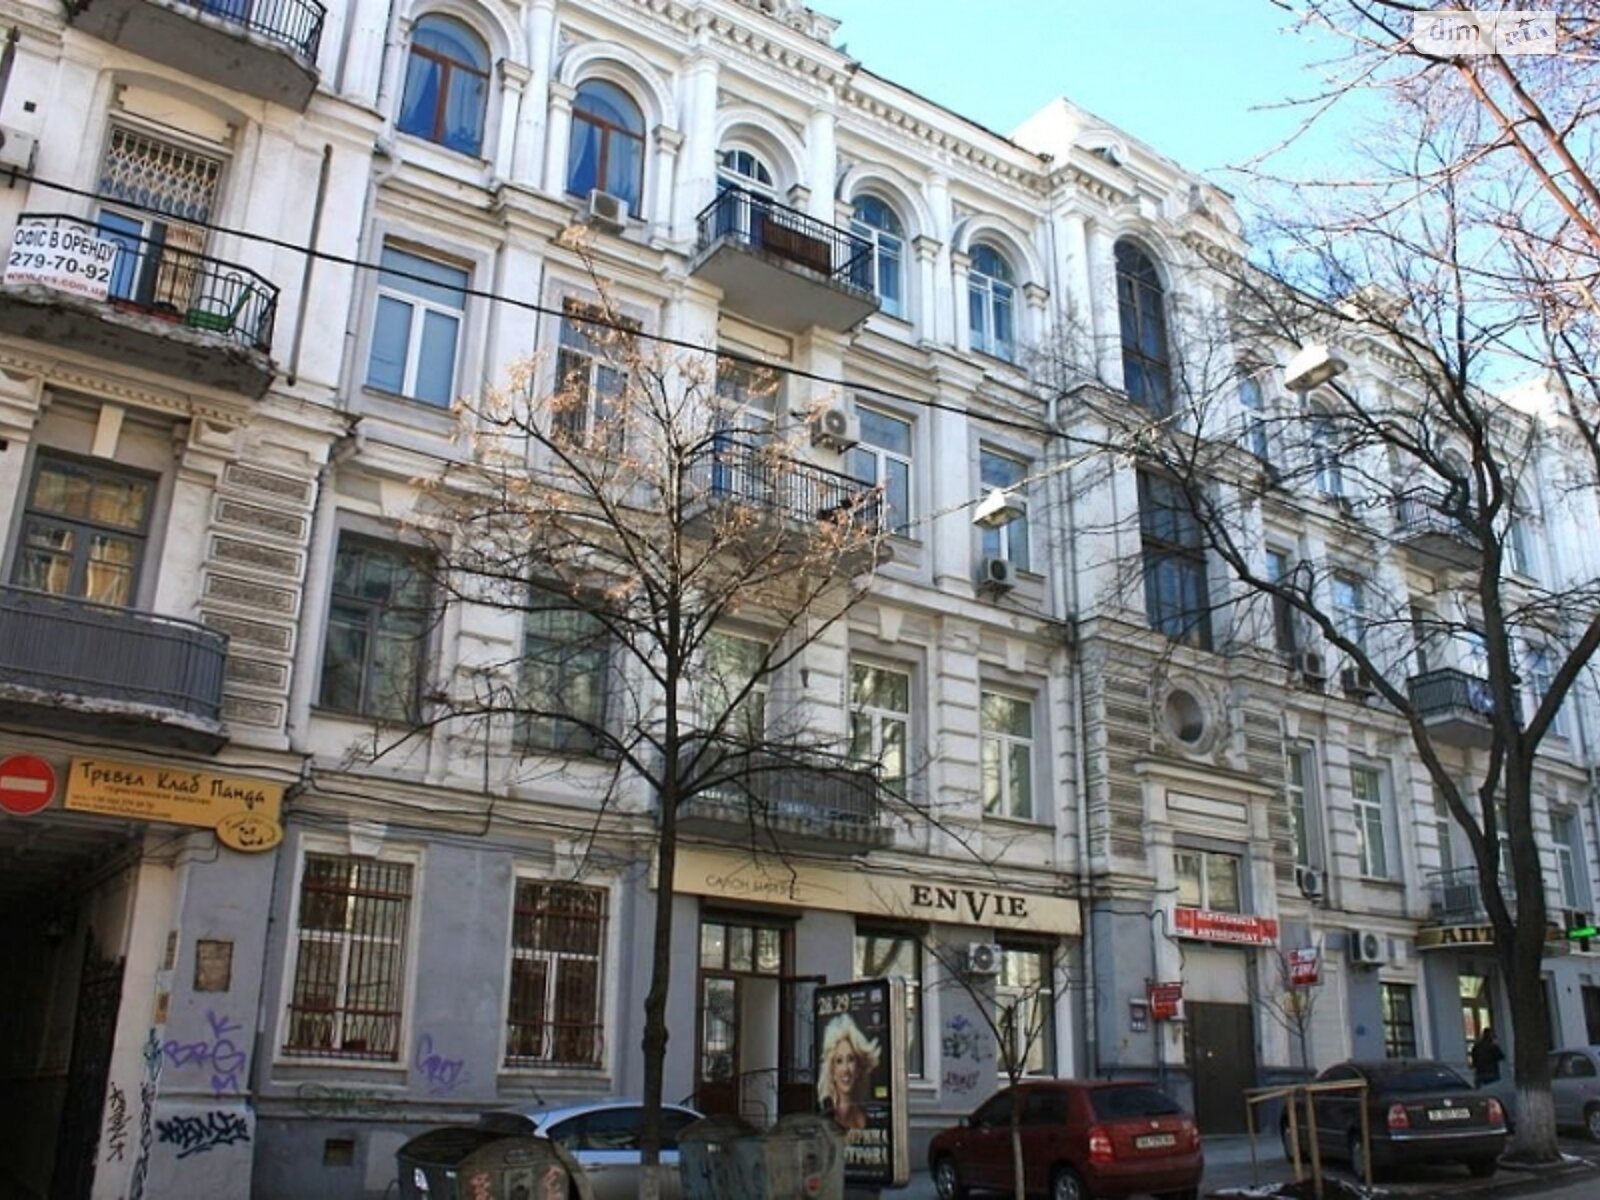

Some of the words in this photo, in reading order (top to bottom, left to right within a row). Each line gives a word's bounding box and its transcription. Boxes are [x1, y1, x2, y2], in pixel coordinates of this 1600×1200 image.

[15, 229, 47, 247] ОФІС
[49, 231, 59, 249] В
[61, 233, 117, 263] ОРЕНДУ
[9, 251, 110, 283] 279-70-92
[81, 762, 145, 787] Тревел
[157, 773, 201, 794] Клаб
[211, 779, 266, 810] Панда
